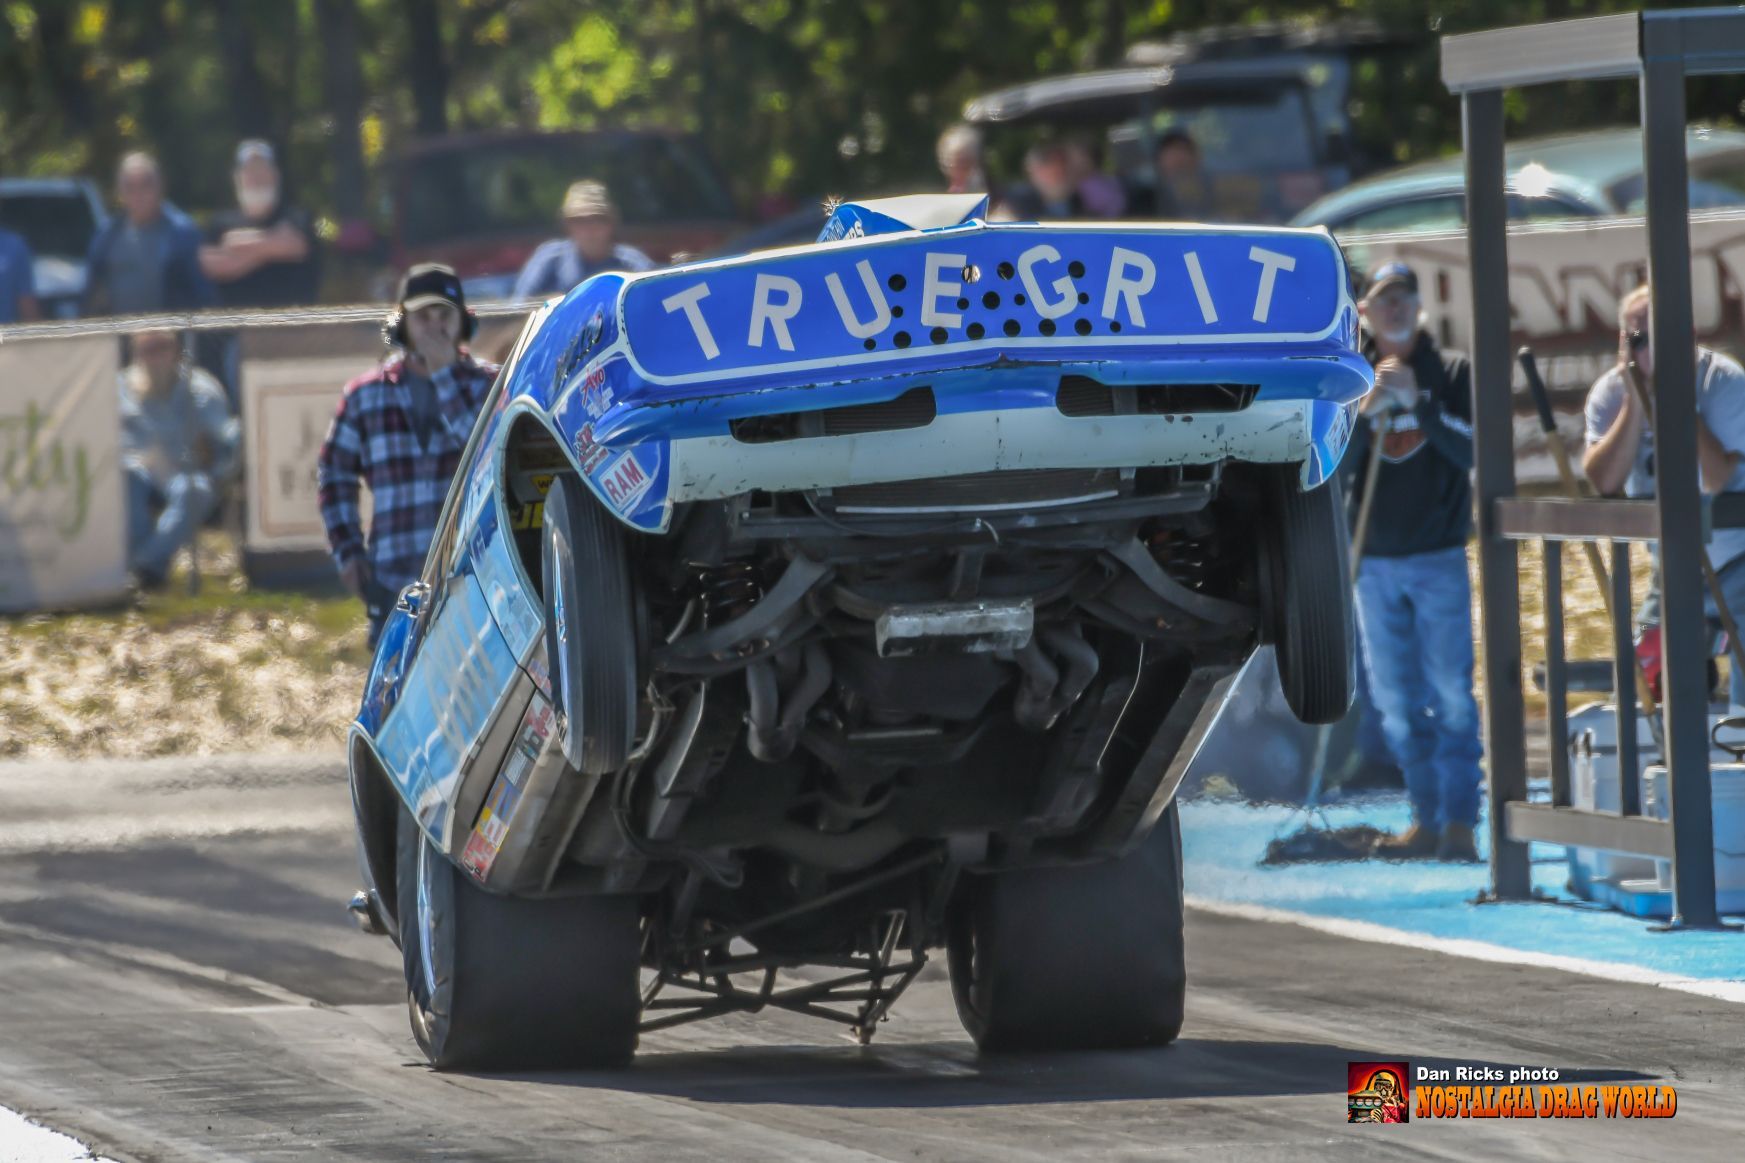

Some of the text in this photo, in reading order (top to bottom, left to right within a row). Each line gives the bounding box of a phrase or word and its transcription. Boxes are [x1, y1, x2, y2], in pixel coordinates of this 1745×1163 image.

[662, 251, 967, 361] TRUE
[1017, 244, 1297, 328] GRIT
[603, 456, 645, 505] RAM
